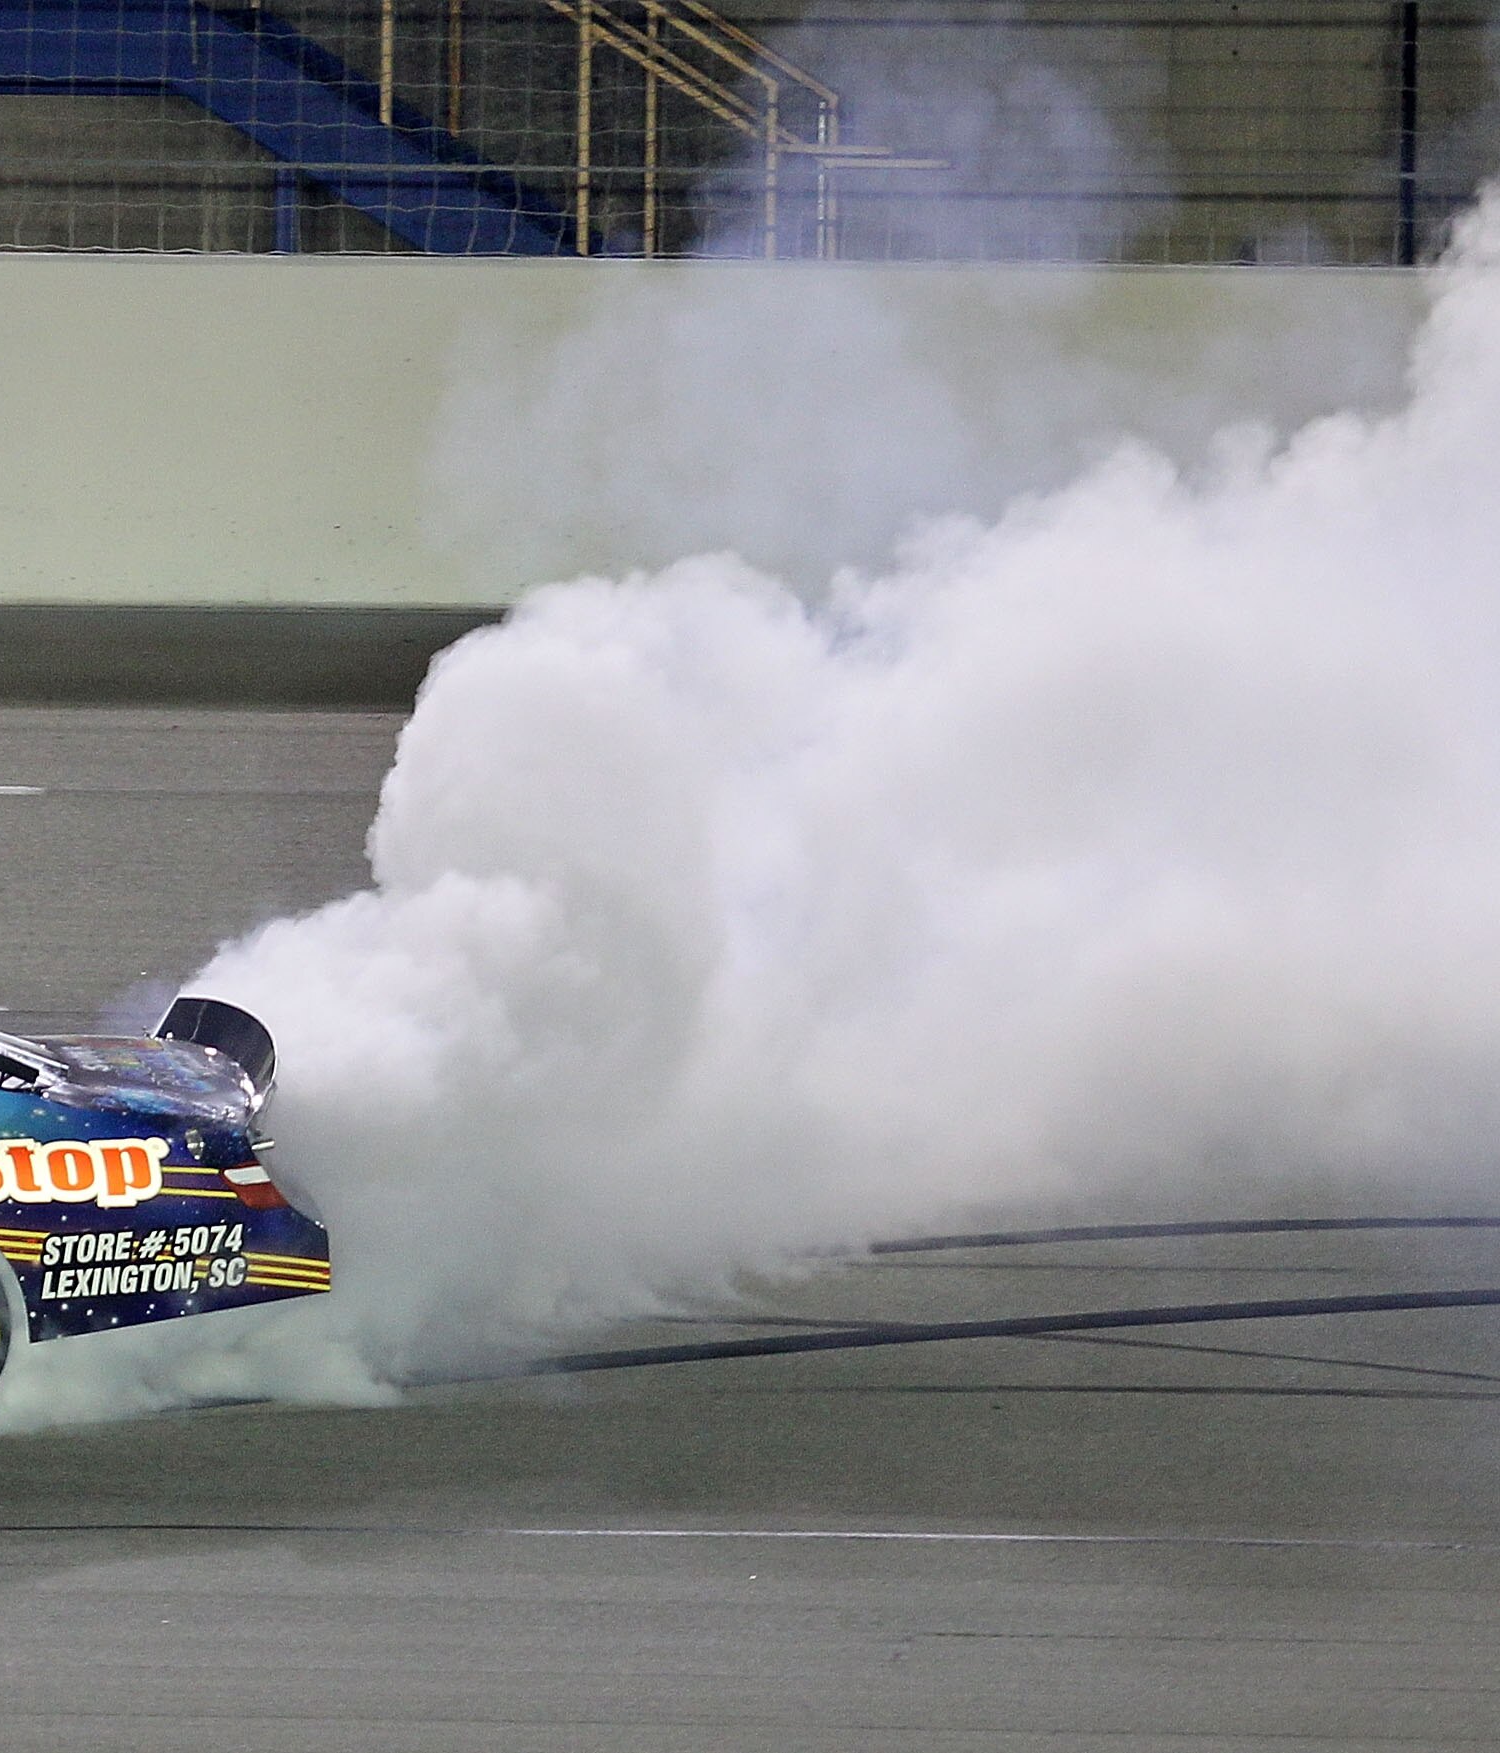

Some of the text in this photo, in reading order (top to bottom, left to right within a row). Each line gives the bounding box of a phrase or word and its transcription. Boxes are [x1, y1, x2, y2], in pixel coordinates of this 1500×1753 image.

[42, 1223, 243, 1266] STORE # 5074
[41, 1257, 246, 1299] LEXINGTON, SC
